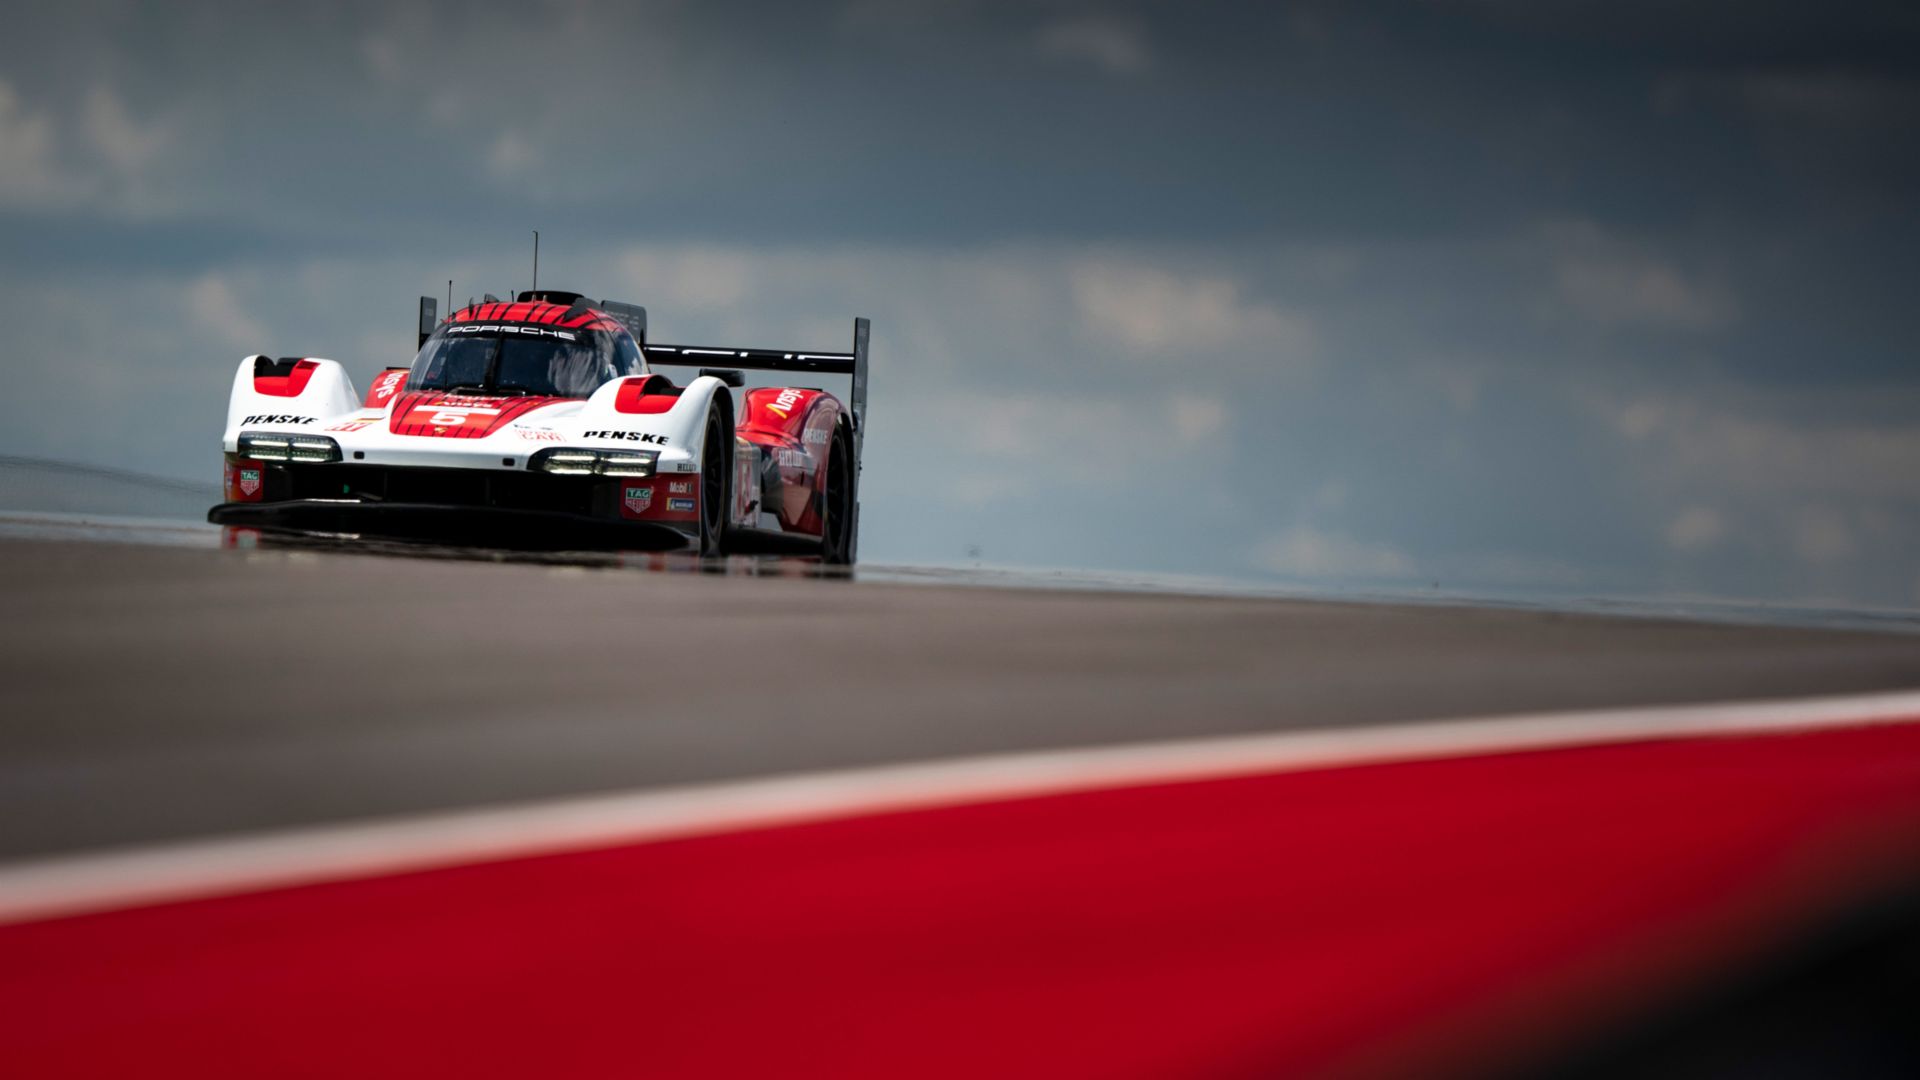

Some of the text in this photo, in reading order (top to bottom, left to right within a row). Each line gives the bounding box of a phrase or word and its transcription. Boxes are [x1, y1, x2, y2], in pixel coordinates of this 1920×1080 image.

[448, 325, 575, 341] PORSCHE
[240, 415, 319, 427] PENSKE
[429, 411, 470, 426] 5
[583, 431, 670, 446] PENSKE
[242, 472, 259, 480] TAG
[669, 482, 688, 493] Mobil
[629, 490, 650, 498] TAG
